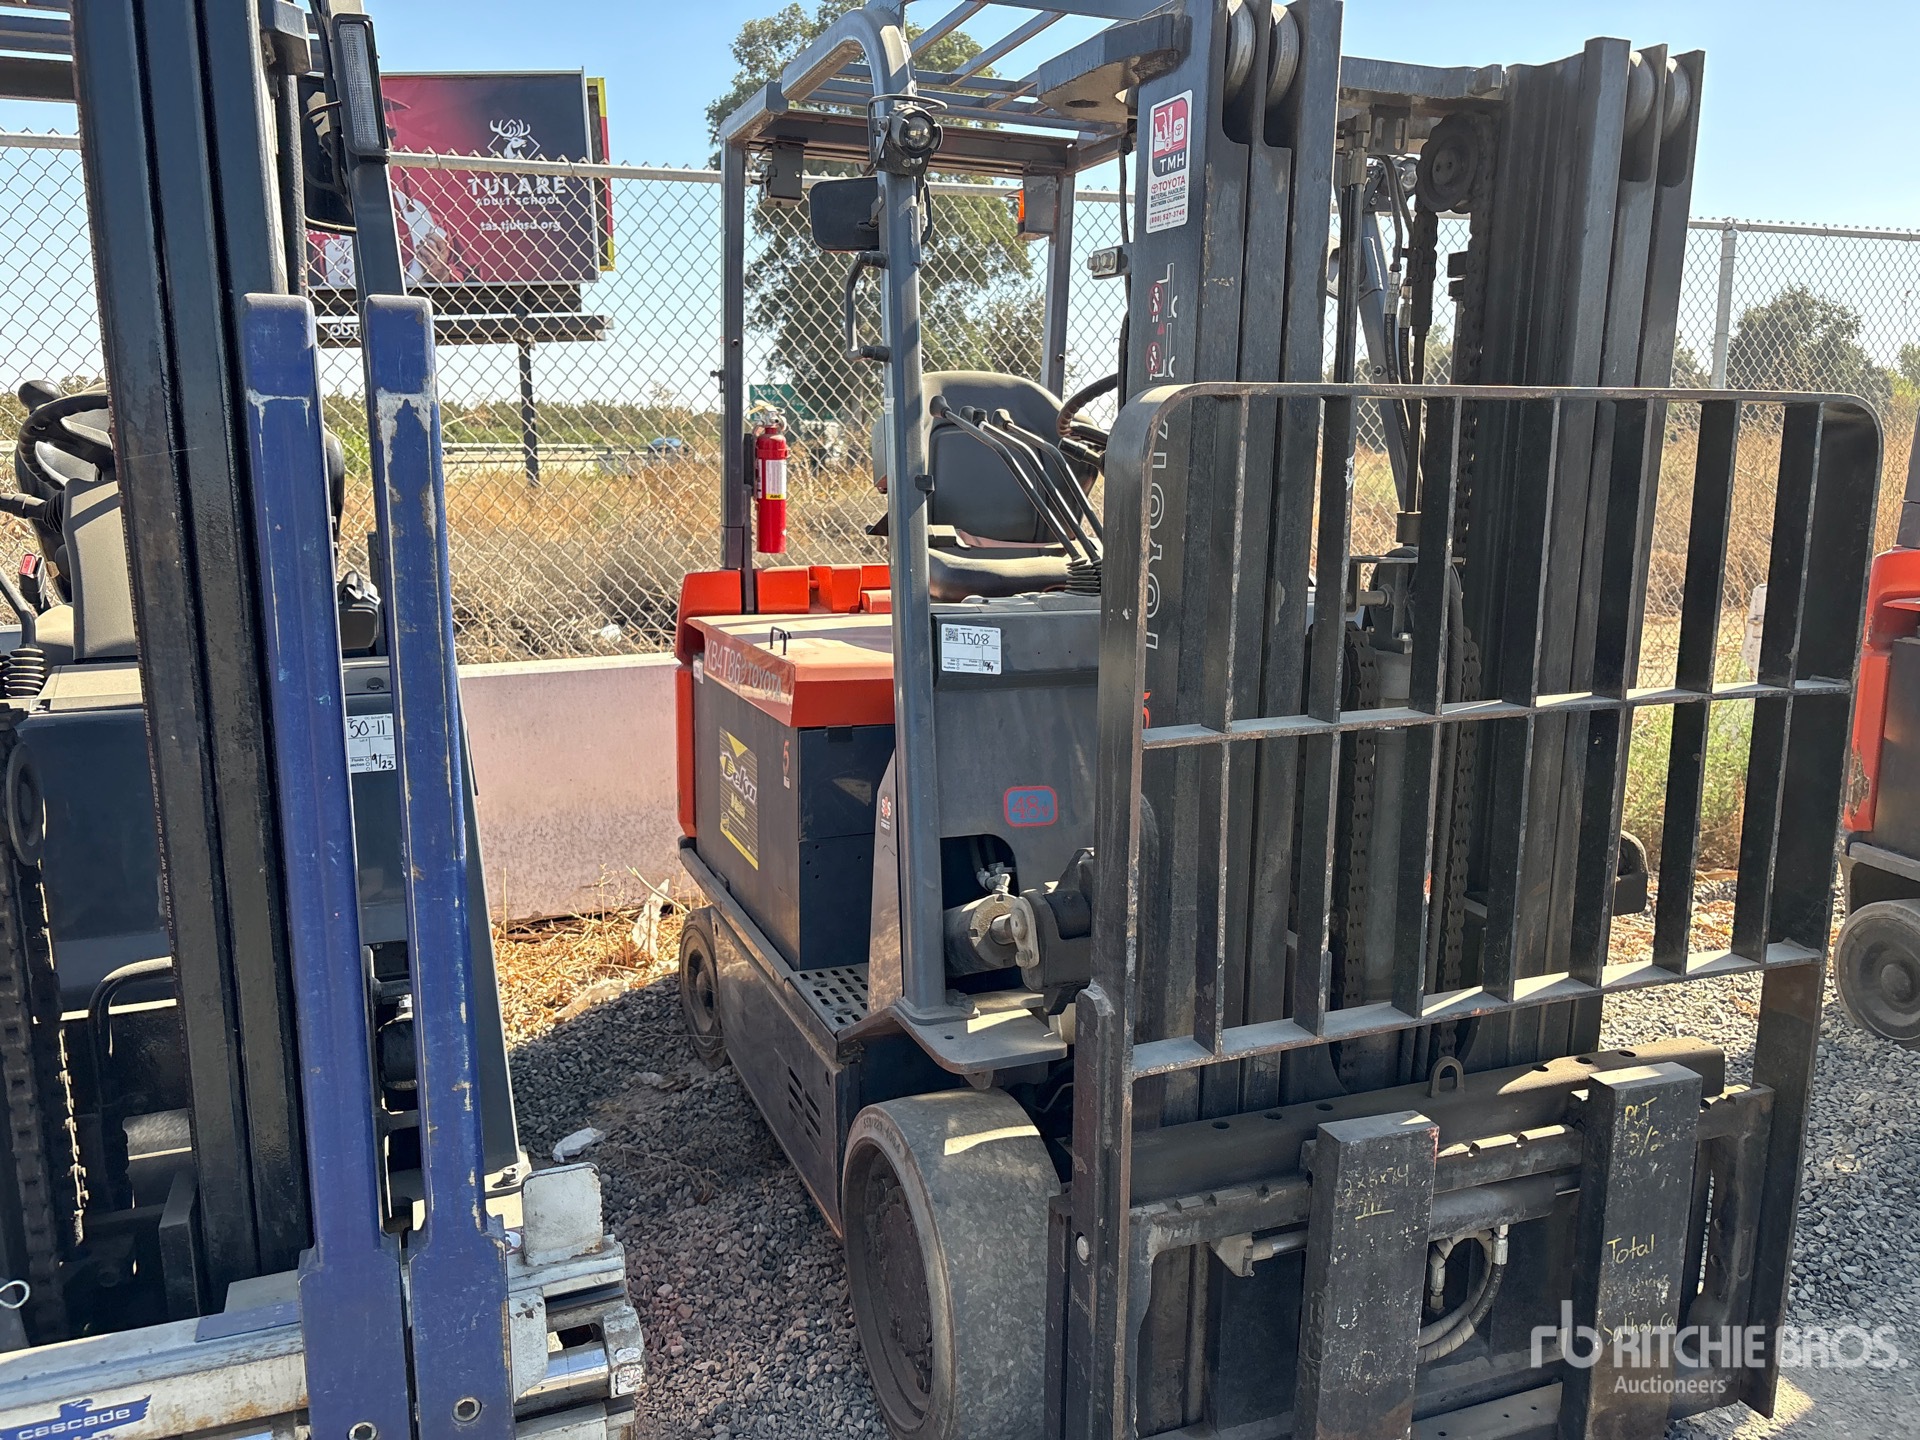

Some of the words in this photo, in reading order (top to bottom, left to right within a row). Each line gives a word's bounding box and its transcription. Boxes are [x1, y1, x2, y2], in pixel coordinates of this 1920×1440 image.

[1160, 152, 1185, 173] TMH
[467, 176, 567, 196] TULARE
[1150, 191, 1168, 200] MATERIAL
[1168, 185, 1186, 195] HANDLING
[1158, 175, 1186, 191] TOYOTA
[475, 197, 511, 206] ADULT
[516, 196, 561, 206] SCHOOL
[748, 661, 782, 701] TOYOTA
[350, 720, 385, 739] 50-11
[371, 753, 394, 770] 9/23
[719, 750, 757, 806] Deka
[1606, 1233, 1656, 1264] Total
[17, 1408, 131, 1440] cascade
